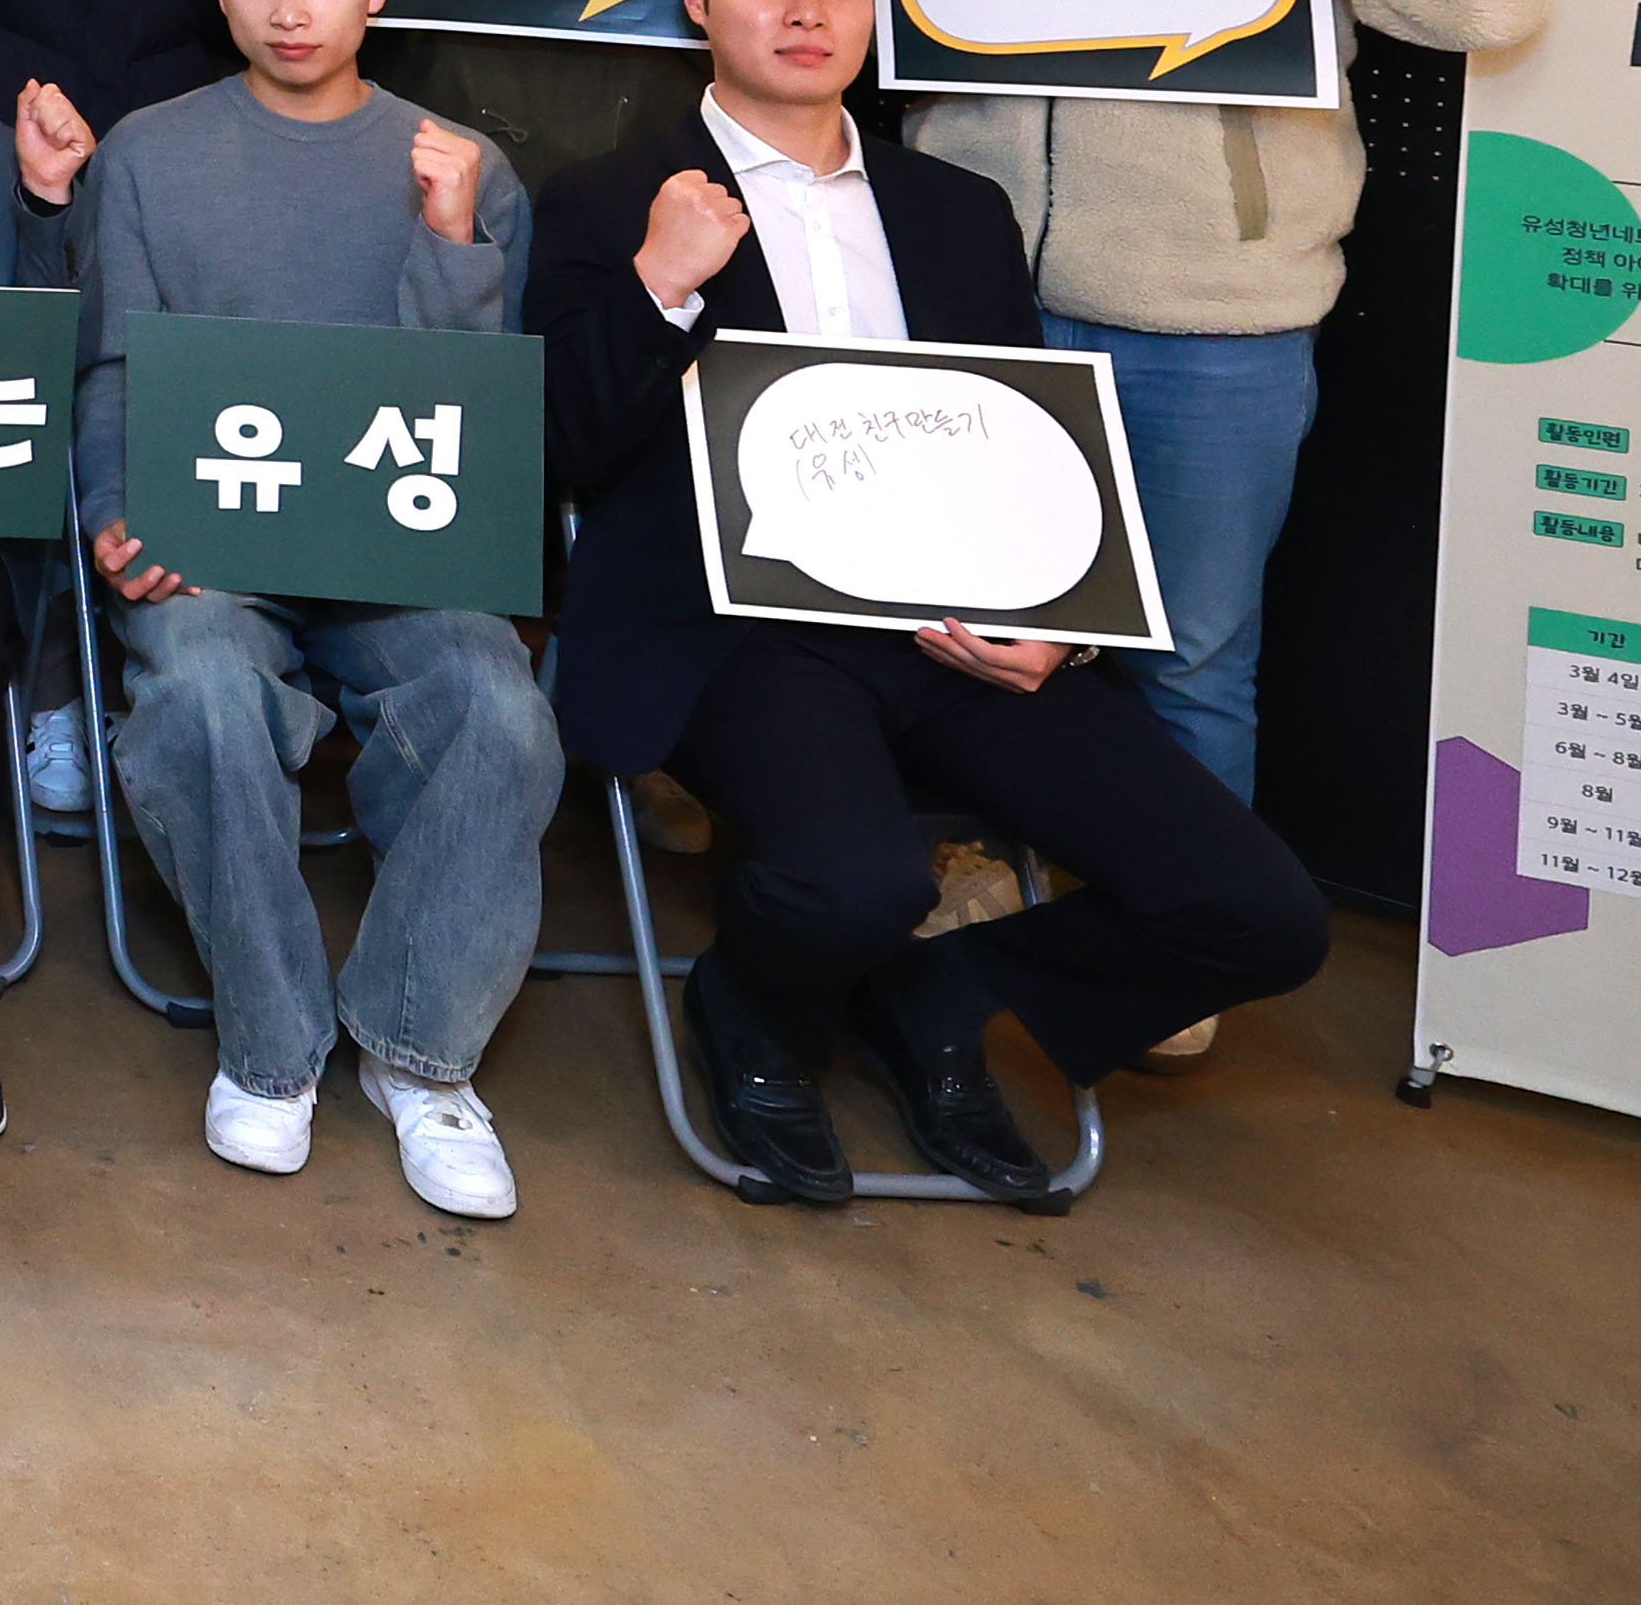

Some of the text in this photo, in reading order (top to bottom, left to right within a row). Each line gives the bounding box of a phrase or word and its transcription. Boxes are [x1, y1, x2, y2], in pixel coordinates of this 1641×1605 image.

[1562, 247, 1606, 269] 정책
[1545, 421, 1621, 449] 활동인원
[1543, 467, 1618, 496] 활동기간
[1540, 515, 1616, 543] 활동내용
[1588, 630, 1626, 649] 기간
[1569, 664, 1639, 691] 3월 4일
[1557, 701, 1589, 721] 3월
[1555, 741, 1586, 760] 6월
[1581, 784, 1613, 803] 8월
[1547, 816, 1577, 835] 9월
[1541, 853, 1579, 873] 11월
